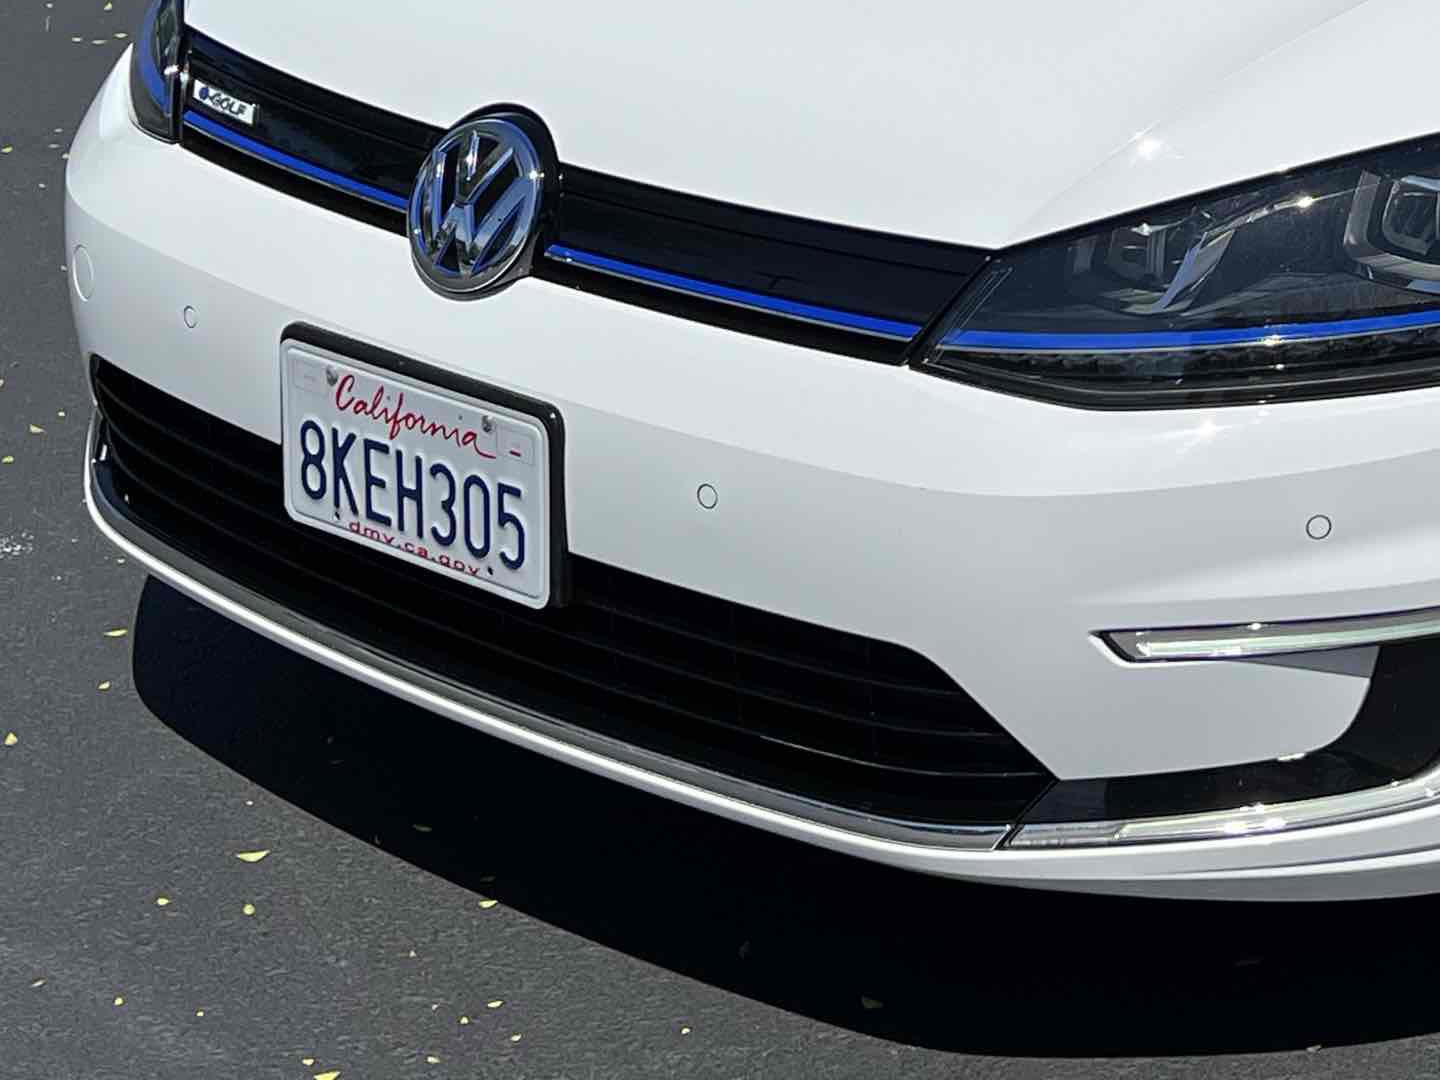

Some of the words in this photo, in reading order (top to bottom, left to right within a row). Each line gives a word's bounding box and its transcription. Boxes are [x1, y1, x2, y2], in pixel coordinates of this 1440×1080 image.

[411, 121, 540, 291] VW
[335, 373, 497, 459] California
[299, 419, 526, 571] 8KEH305
[348, 520, 481, 577] dmv.ca.gov
